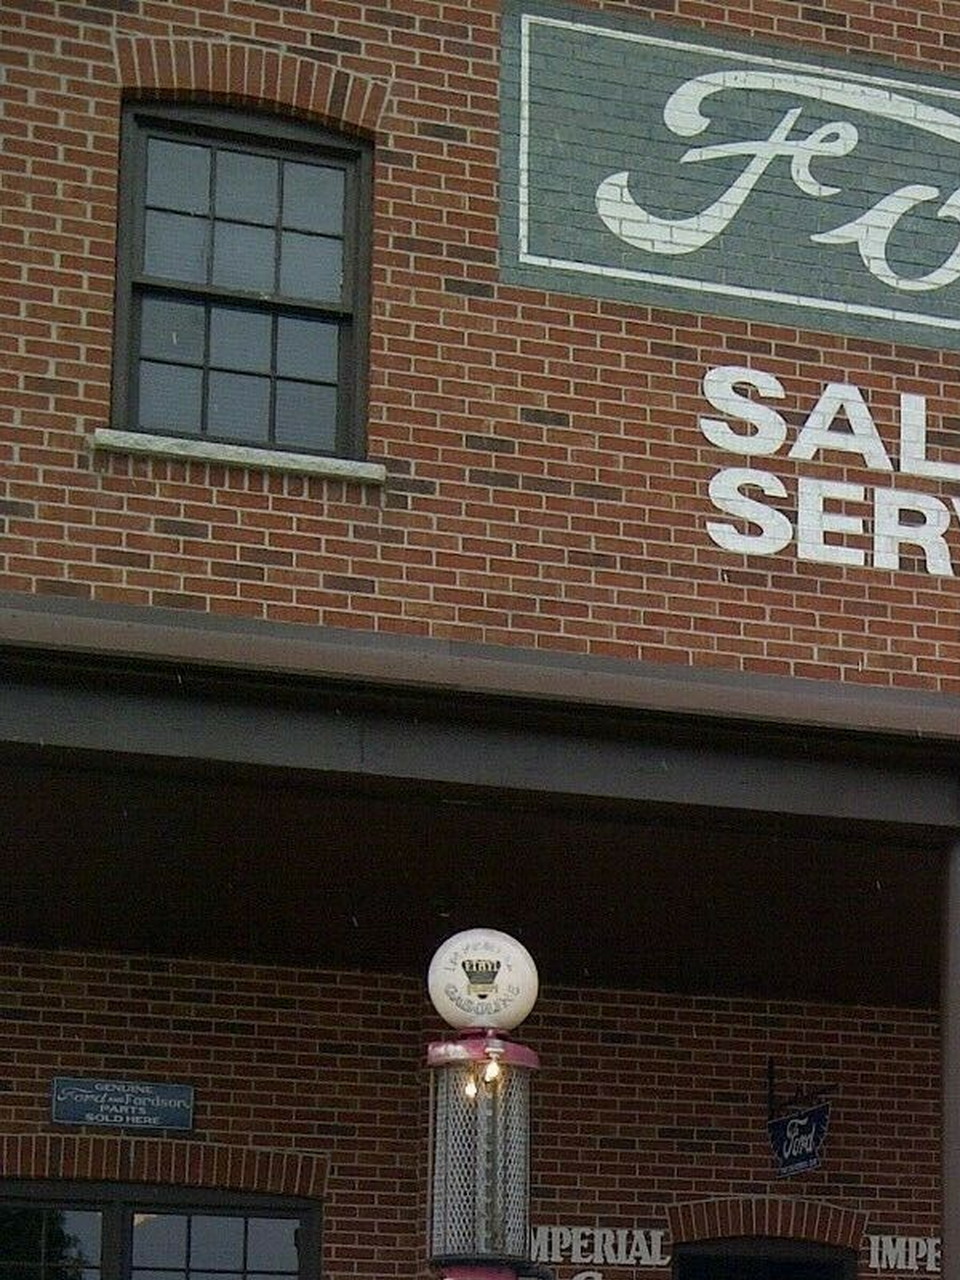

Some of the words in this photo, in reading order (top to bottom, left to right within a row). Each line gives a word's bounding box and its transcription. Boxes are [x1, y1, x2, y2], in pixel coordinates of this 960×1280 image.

[94, 1082, 154, 1095] GENUINE
[57, 1086, 108, 1102] Ford
[124, 1093, 193, 1110] Fordson
[85, 1113, 123, 1124] SOLD
[126, 1115, 160, 1125] HERE
[100, 1105, 146, 1115] PARTS
[782, 1116, 816, 1159] Ford
[531, 1225, 671, 1266] MPERIAL
